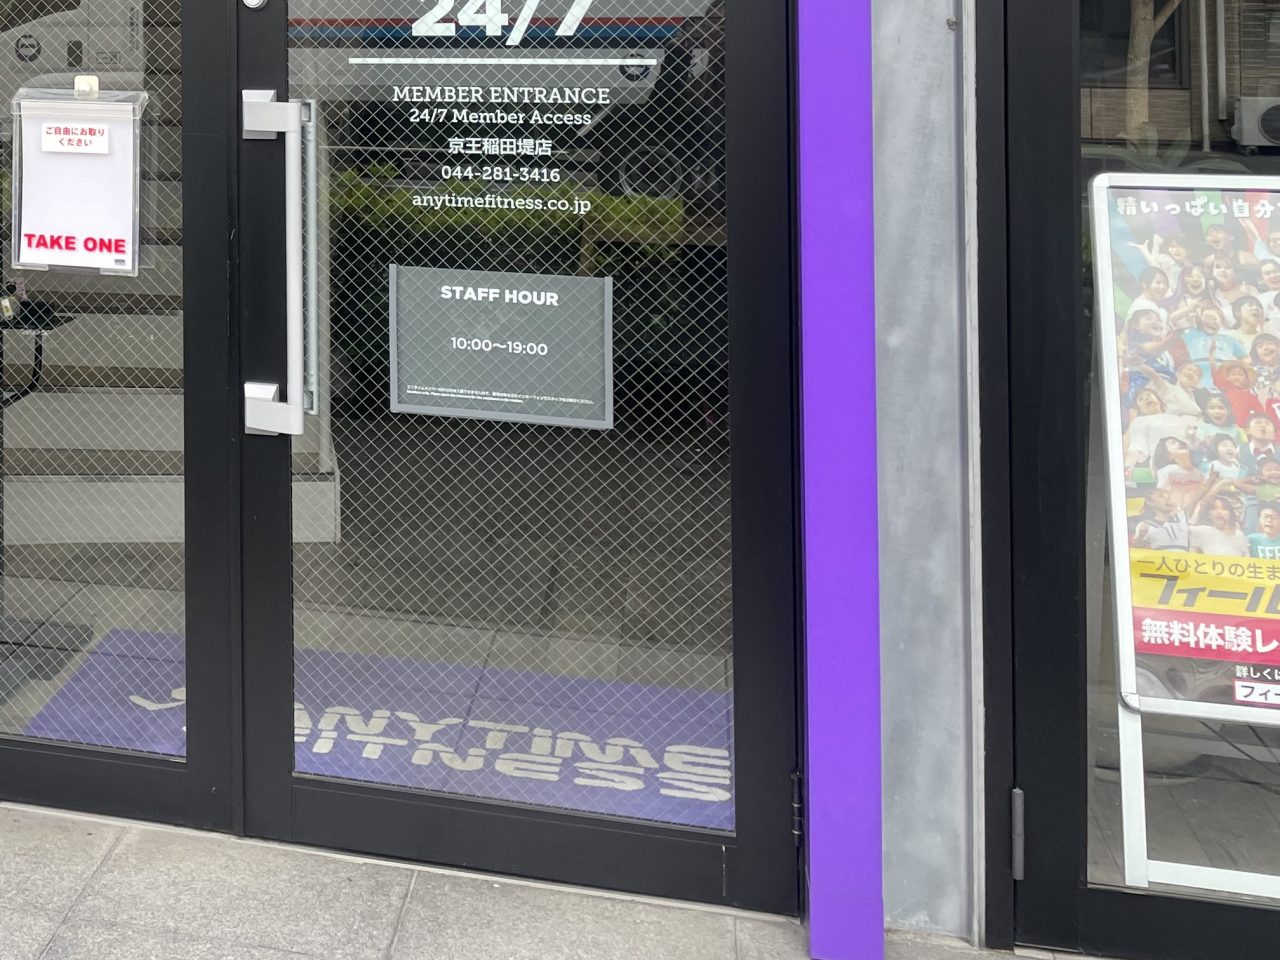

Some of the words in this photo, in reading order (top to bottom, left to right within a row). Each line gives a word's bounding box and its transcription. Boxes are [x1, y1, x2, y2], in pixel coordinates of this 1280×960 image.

[393, 86, 483, 103] MEMBER
[489, 87, 610, 104] ENTRANCE
[409, 109, 448, 124] 24/7
[451, 109, 525, 124] Member
[529, 110, 592, 125] Access
[45, 126, 105, 137] ご自由にお取り
[58, 138, 93, 147] ください
[447, 137, 552, 157] 京王稲田堤店
[441, 166, 560, 182] 044-281-3416
[412, 193, 591, 214] anytimefitness.co.jp
[1116, 195, 1280, 219] 精いっぱい自分
[23, 233, 76, 251] TAKE
[83, 236, 126, 254] ONE
[440, 285, 500, 303] STAFF
[504, 289, 559, 306] HOUR
[1141, 618, 1280, 654] 無料体験レ
[294, 728, 732, 802] ITNESS
